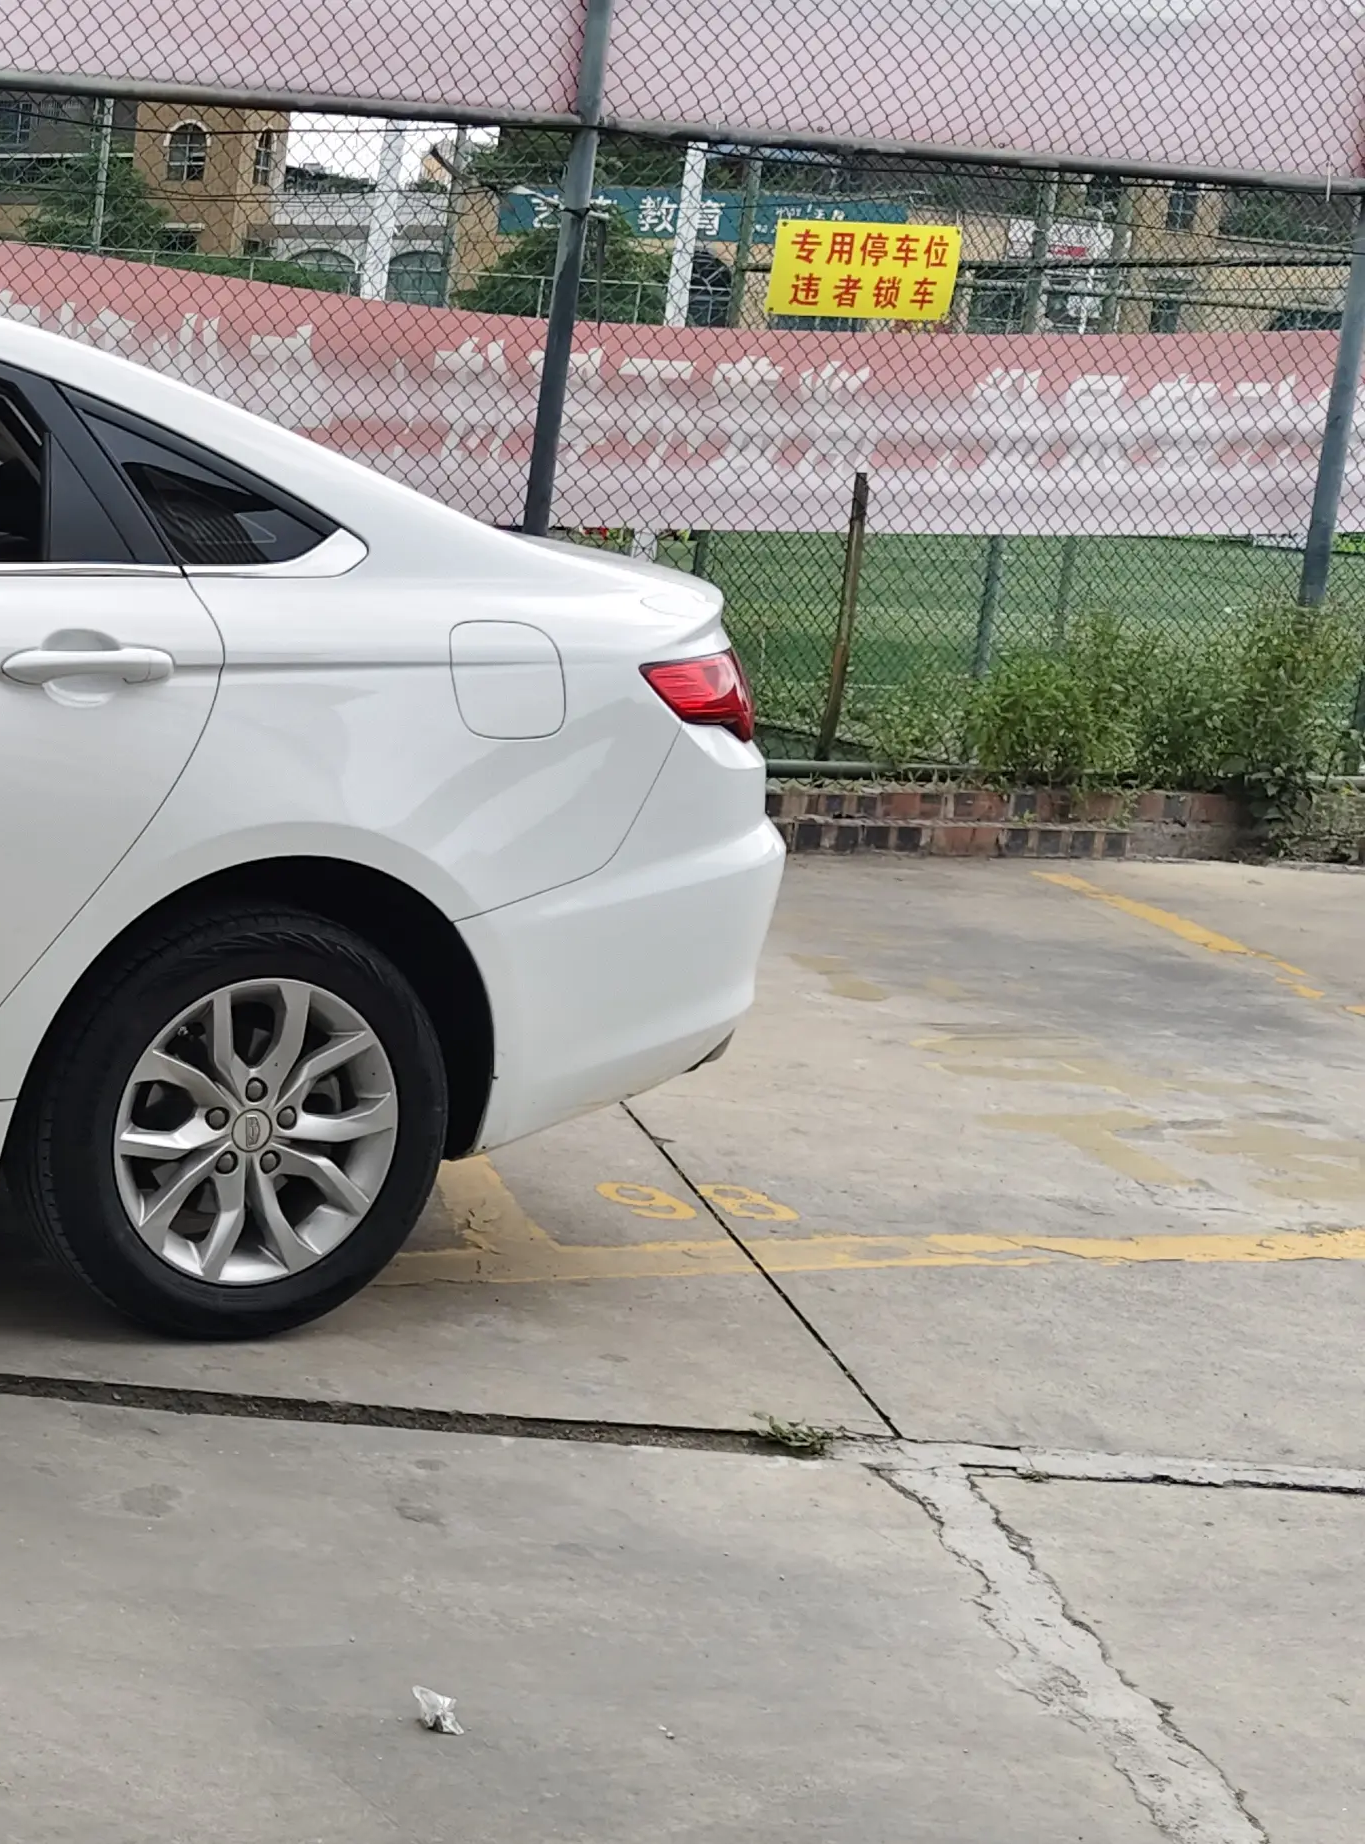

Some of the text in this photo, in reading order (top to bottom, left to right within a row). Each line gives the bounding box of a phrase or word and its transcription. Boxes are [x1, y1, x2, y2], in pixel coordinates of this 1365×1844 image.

[791, 229, 949, 269] 专用停车位
[788, 273, 937, 311] 违者锁车
[595, 1181, 800, 1221] 98
